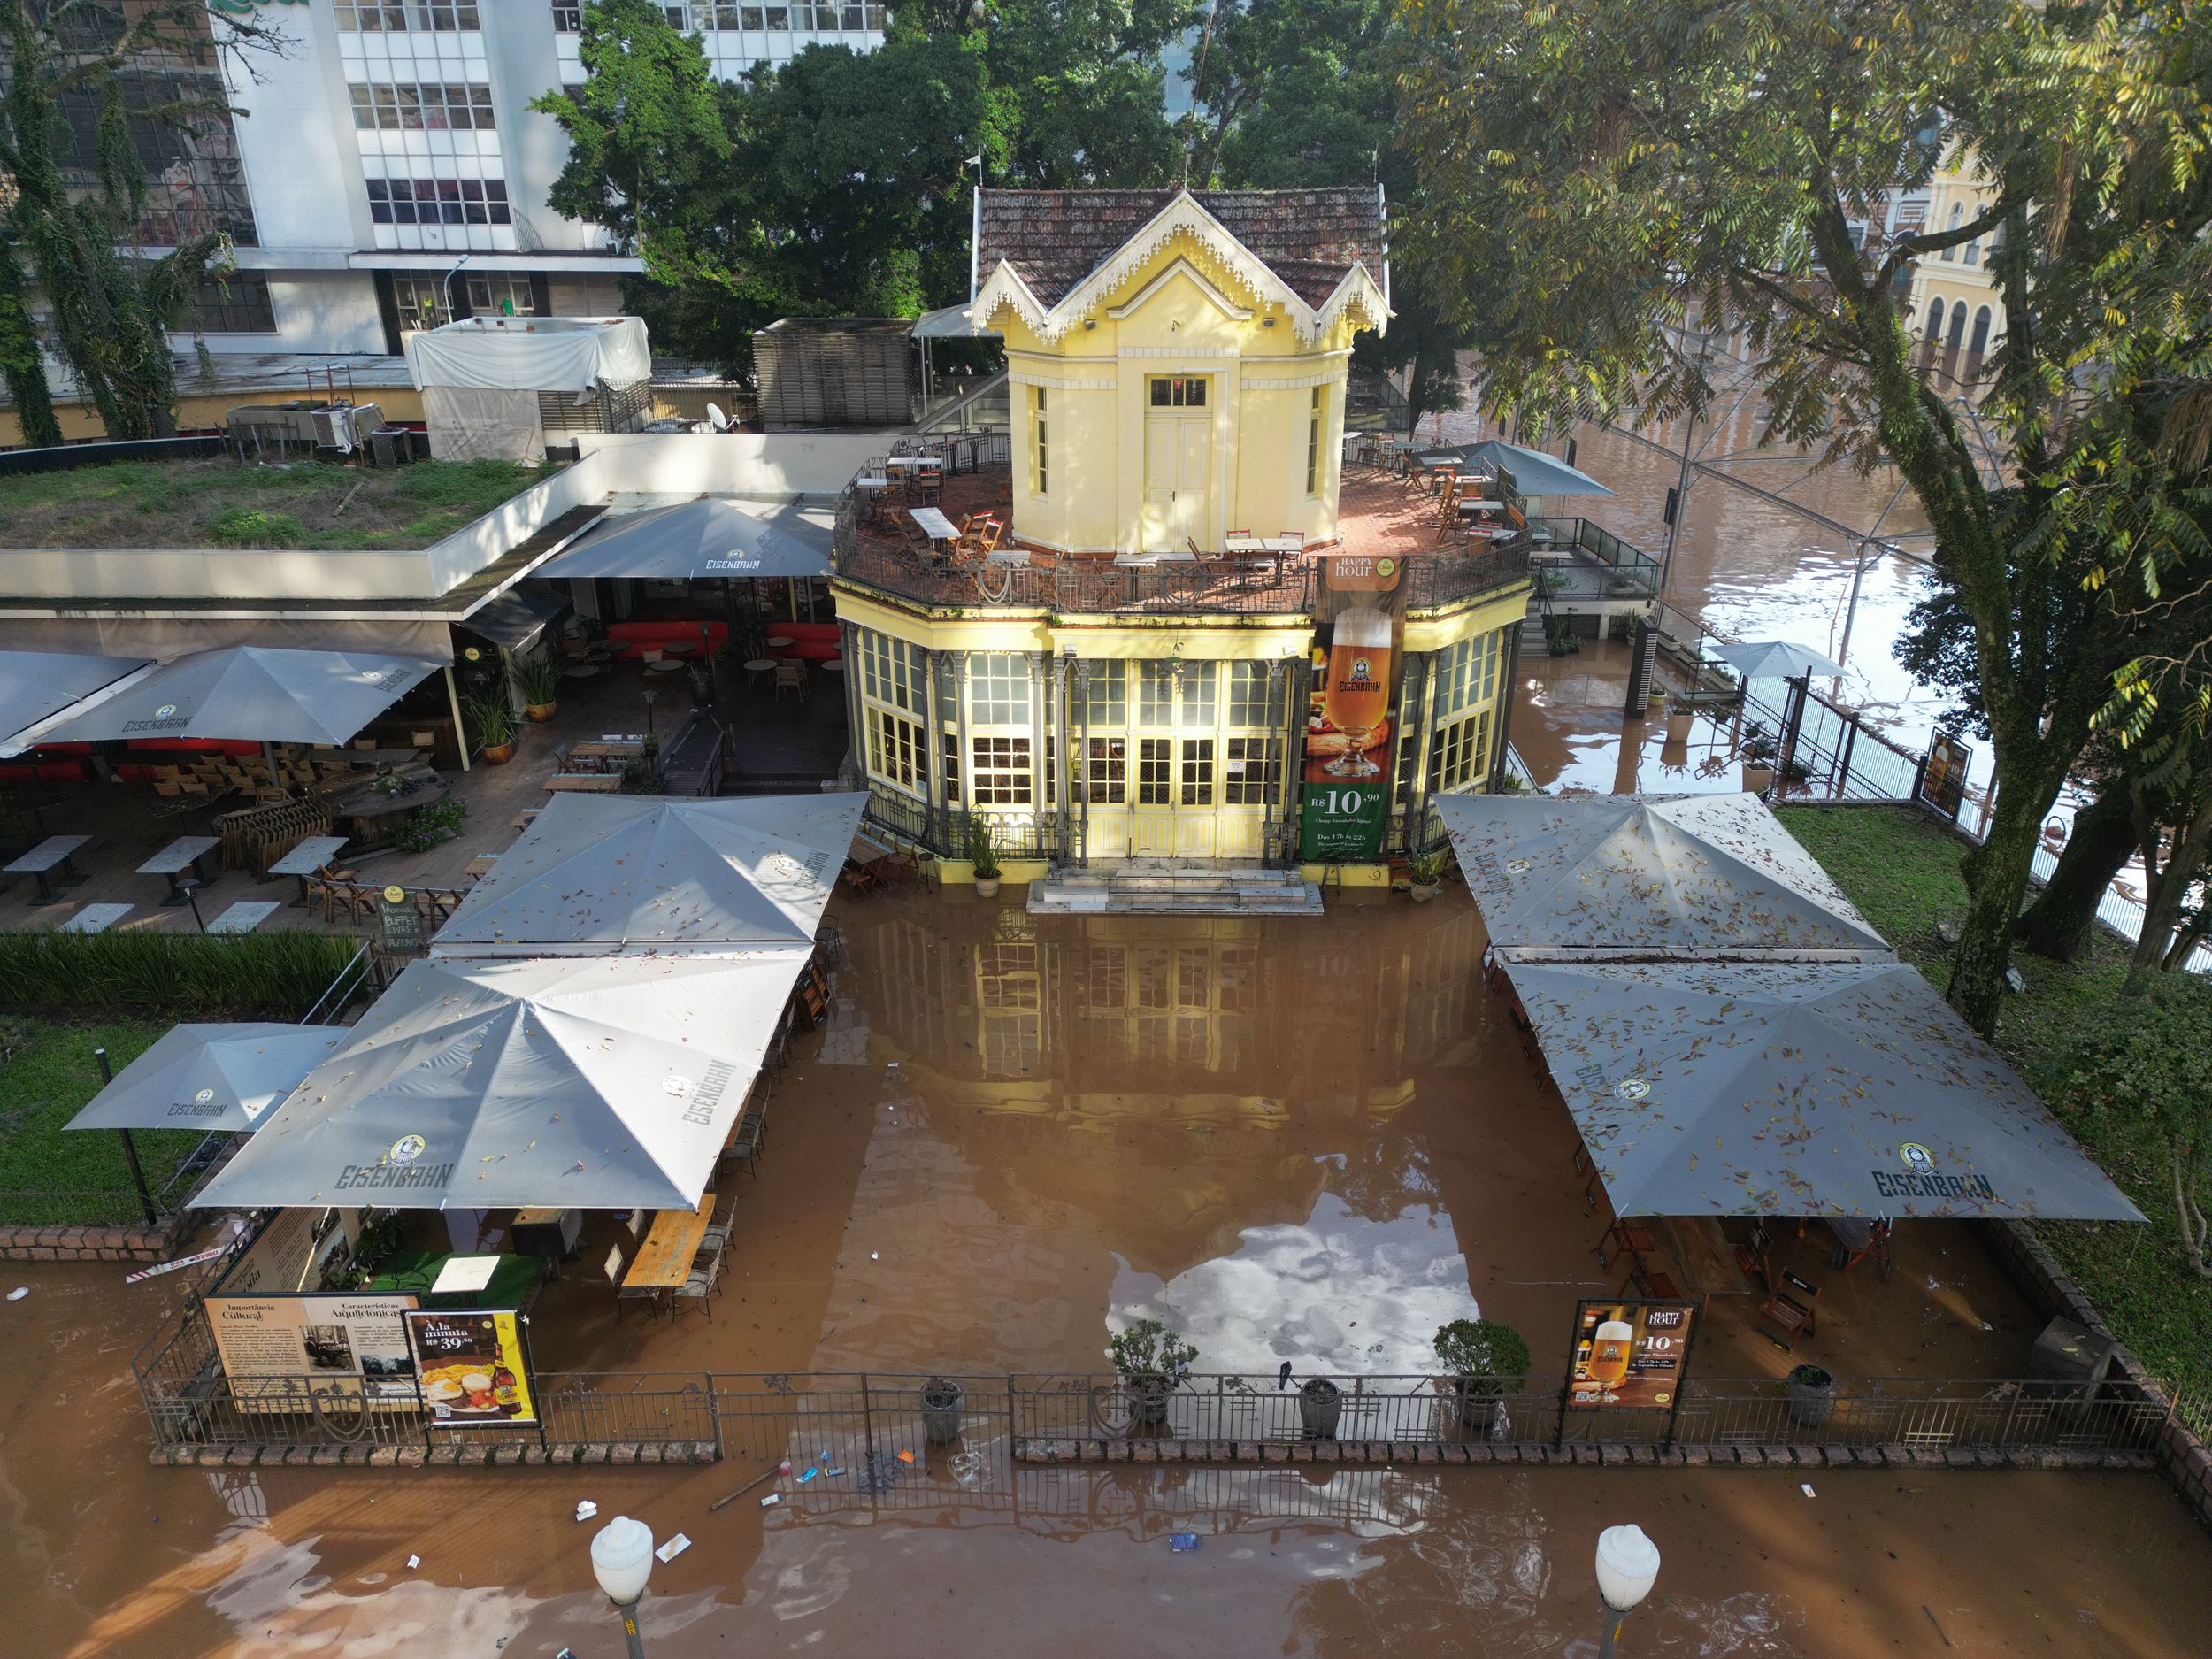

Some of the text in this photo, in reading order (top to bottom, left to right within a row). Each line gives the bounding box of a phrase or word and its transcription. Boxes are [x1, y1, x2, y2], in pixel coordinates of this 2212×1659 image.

[705, 559, 760, 569] EISENBAHN
[1335, 561, 1372, 577] hour
[373, 668, 413, 693] EISENBAHN
[1339, 680, 1380, 693] EISENBAHN
[121, 716, 193, 733] EISENBAHN
[795, 849, 831, 890] EISENBAHN
[384, 916, 418, 926] BUFFET
[387, 926, 413, 934] LIVRE
[682, 1059, 737, 1125] EISENBAHN
[168, 1103, 227, 1117] EISENBAHN
[334, 1164, 457, 1189] EISENBAHN
[195, 1250, 219, 1261] DMAE
[332, 1309, 401, 1319] Arquitetônicas
[1648, 1315, 1679, 1325] hour
[425, 1329, 468, 1338] minuta
